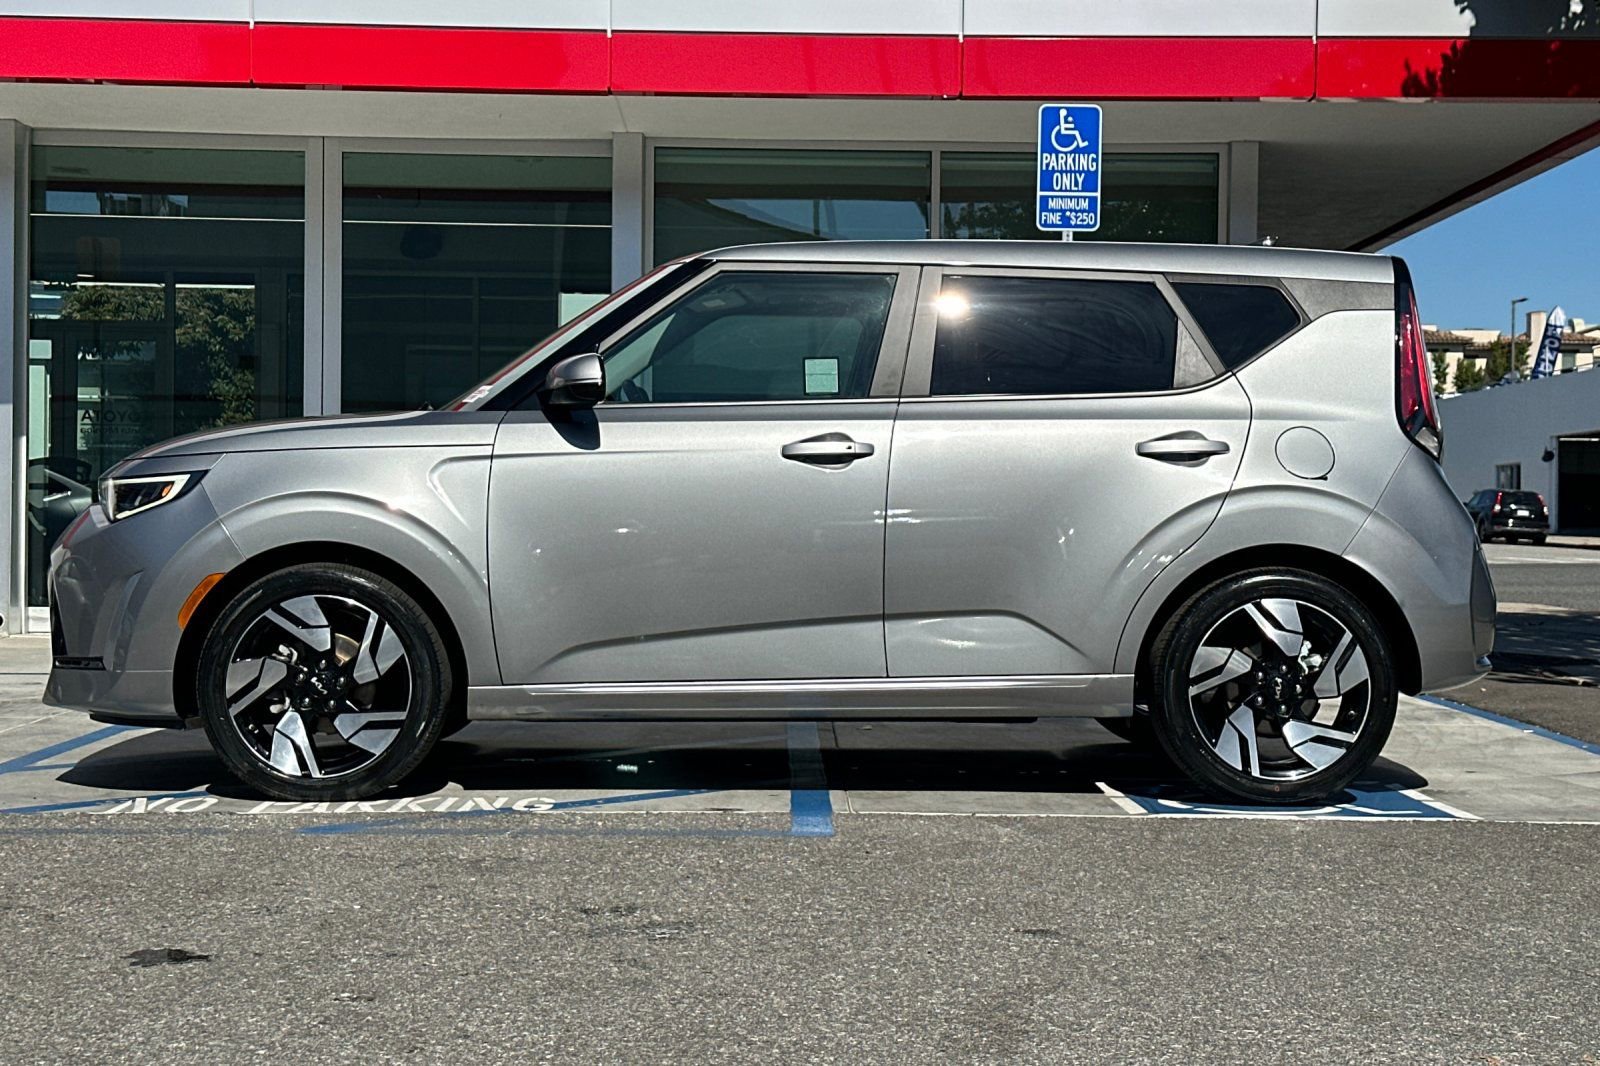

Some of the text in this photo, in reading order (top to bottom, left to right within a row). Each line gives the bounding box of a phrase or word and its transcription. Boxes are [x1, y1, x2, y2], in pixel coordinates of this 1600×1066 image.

[1042, 153, 1097, 171] PARKING
[1052, 172, 1085, 191] ONLY
[1048, 198, 1089, 210] MINIMUM
[1041, 212, 1095, 226] FINE $250
[88, 797, 219, 815] NO
